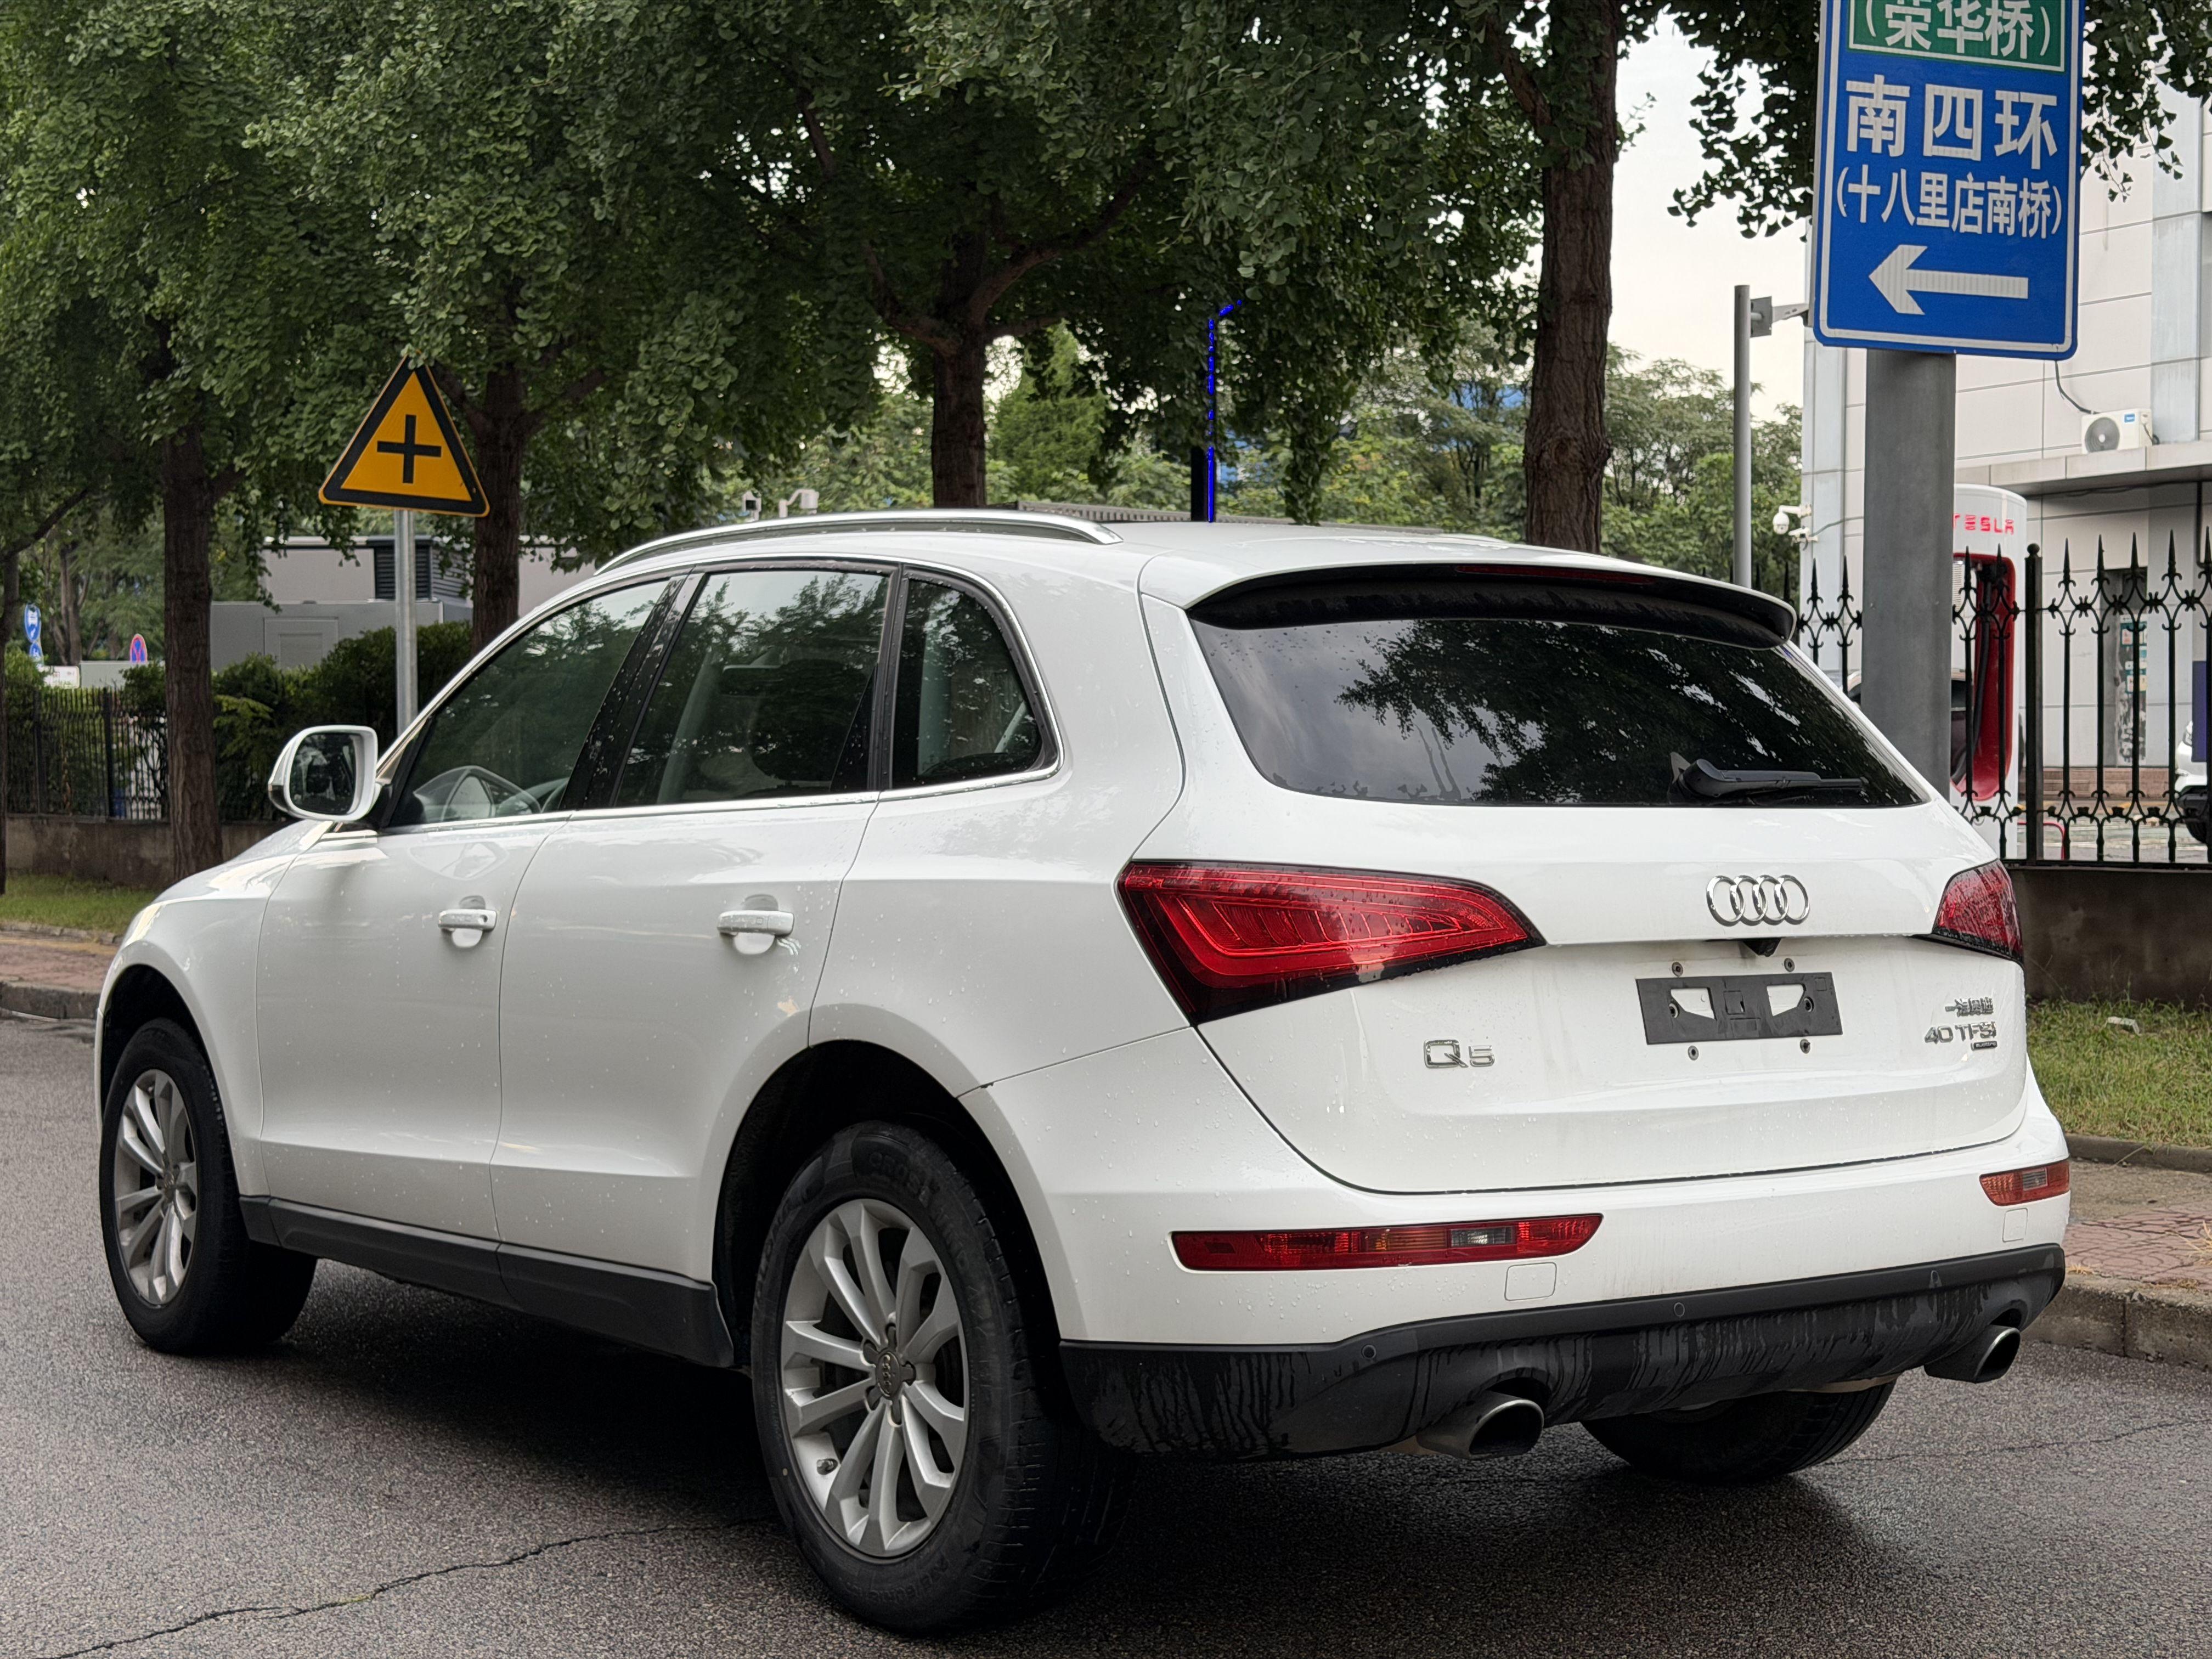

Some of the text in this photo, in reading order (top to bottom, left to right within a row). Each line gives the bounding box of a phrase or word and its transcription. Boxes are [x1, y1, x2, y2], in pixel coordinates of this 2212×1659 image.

[1846, 74, 2058, 170] 南四环
[1836, 164, 2063, 240] (十八里店南桥)
[1424, 1040, 1495, 1068] Q5
